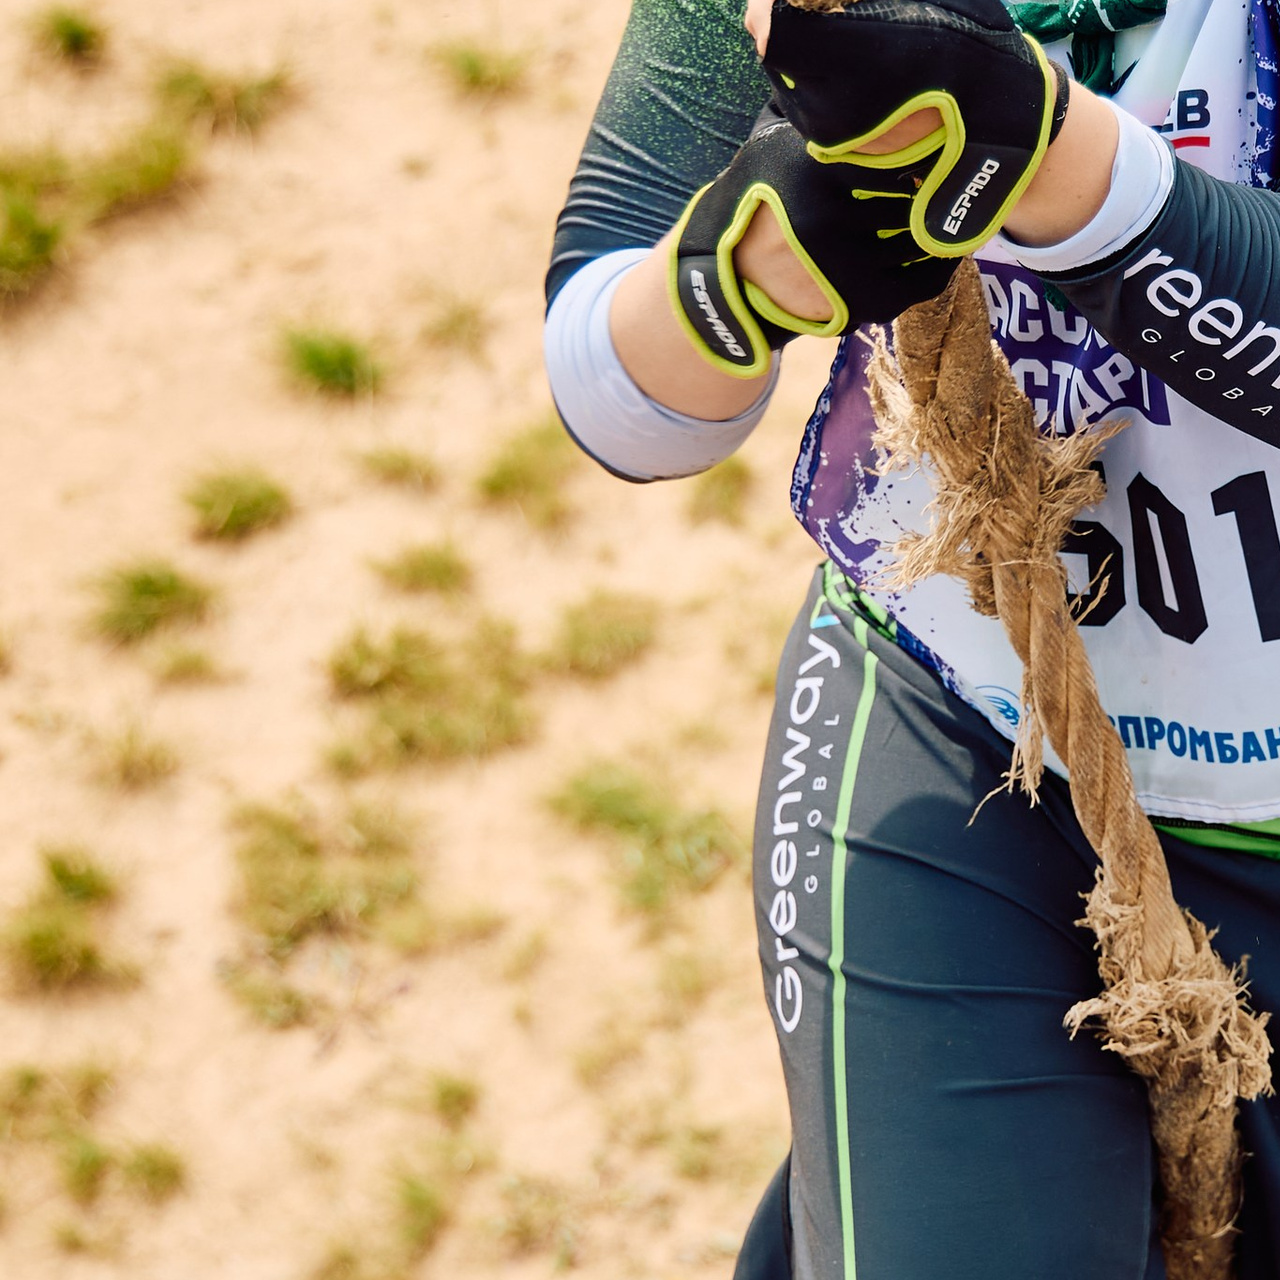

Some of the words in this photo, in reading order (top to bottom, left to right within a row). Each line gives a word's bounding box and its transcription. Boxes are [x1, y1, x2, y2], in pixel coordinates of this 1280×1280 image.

[943, 158, 1000, 236] ESPADO
[690, 268, 747, 358] ESPADO
[768, 634, 842, 1034] Greenway
[803, 713, 841, 894] GLOBAL
